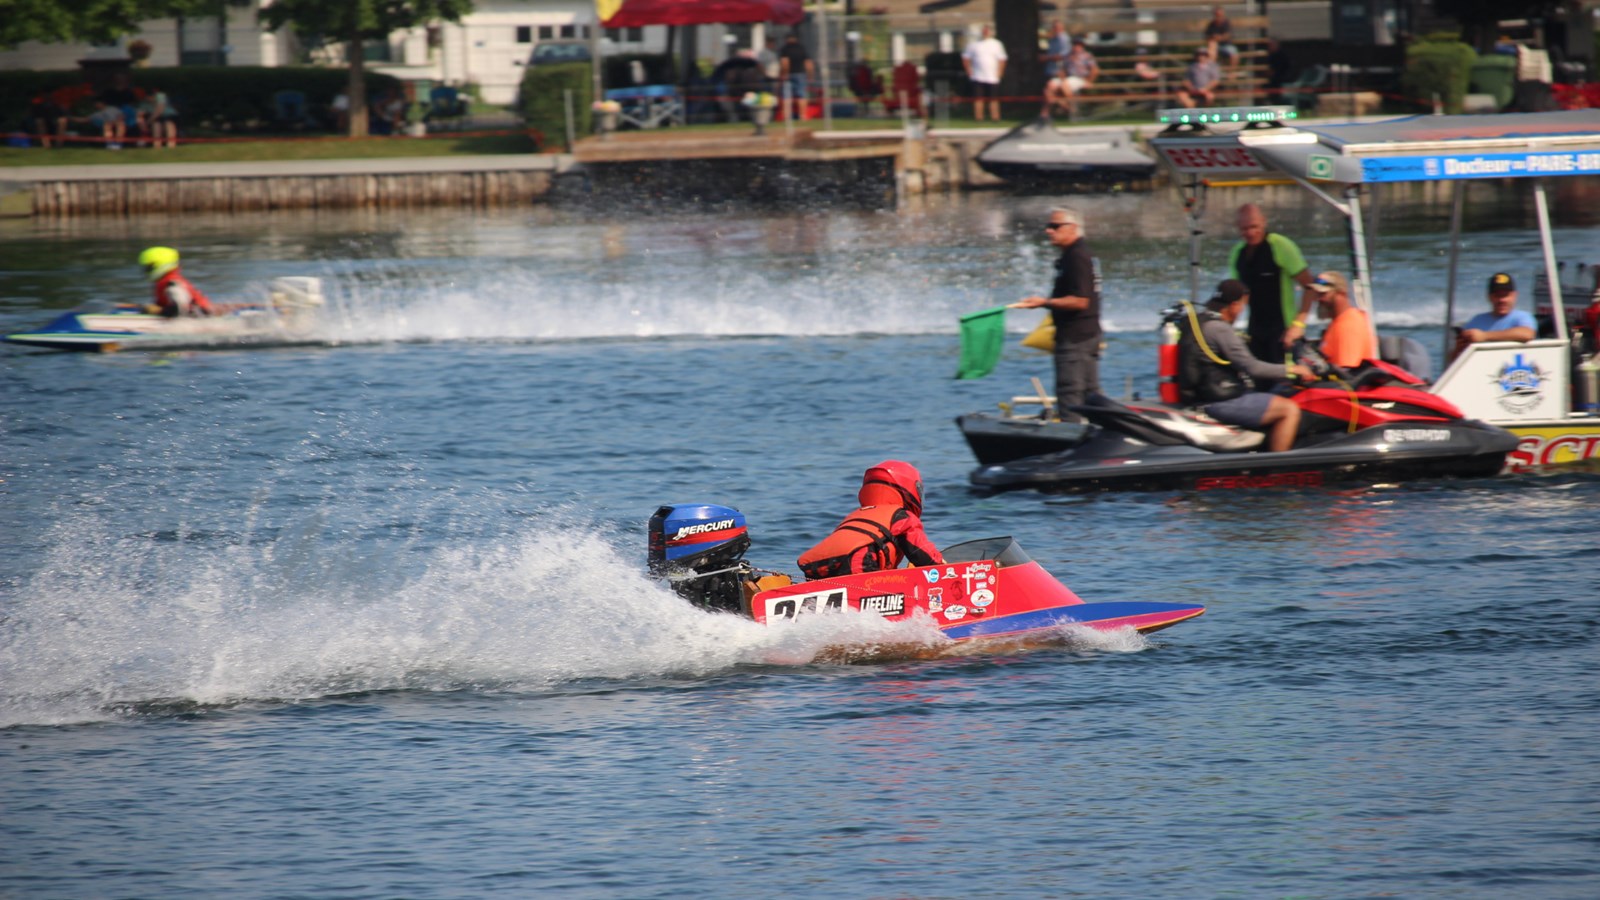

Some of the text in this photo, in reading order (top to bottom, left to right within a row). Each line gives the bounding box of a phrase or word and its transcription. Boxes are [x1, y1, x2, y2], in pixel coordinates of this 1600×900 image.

[1167, 148, 1259, 167] RESCUE
[673, 519, 734, 540] MERCURY
[860, 594, 904, 612] LIFELINE
